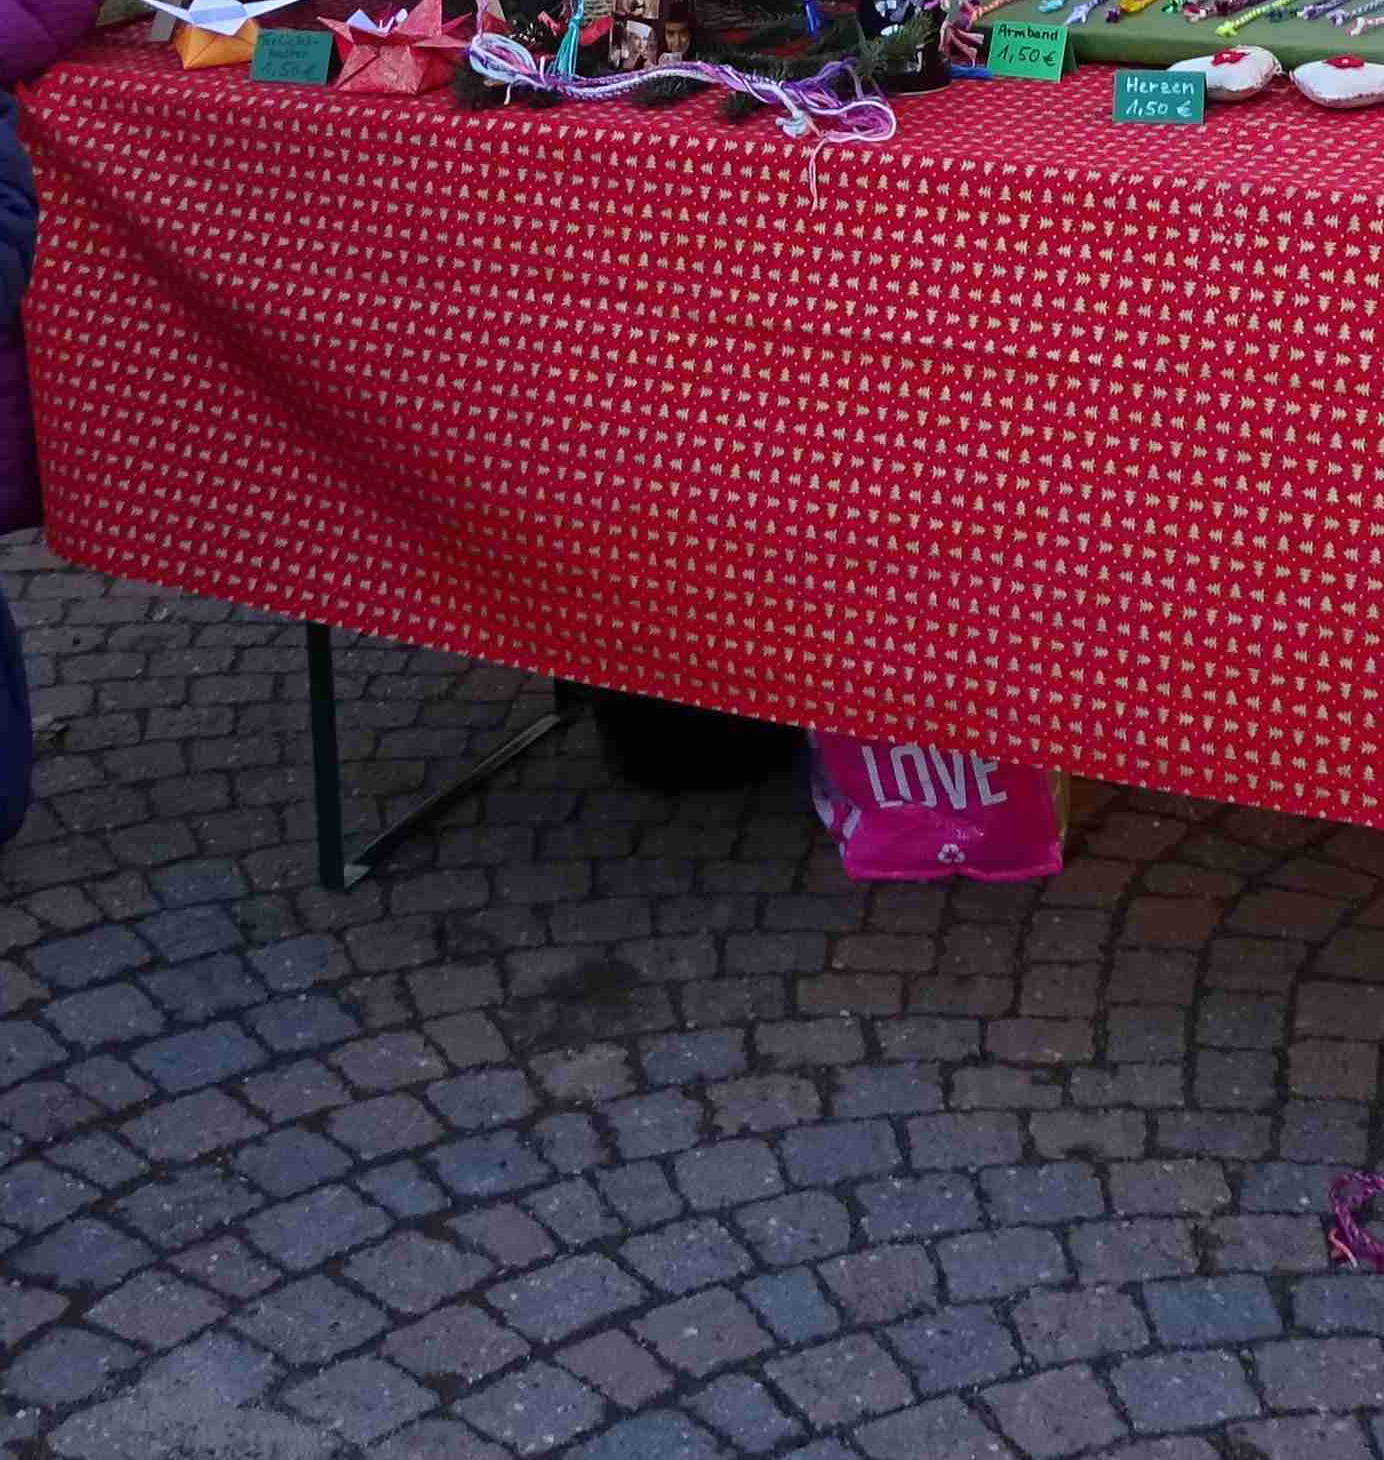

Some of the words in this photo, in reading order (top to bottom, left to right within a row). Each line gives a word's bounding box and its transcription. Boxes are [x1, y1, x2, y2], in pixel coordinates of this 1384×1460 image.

[998, 24, 1059, 41] Armband
[1126, 75, 1195, 96] Herzen
[861, 742, 1008, 811] LOVE
